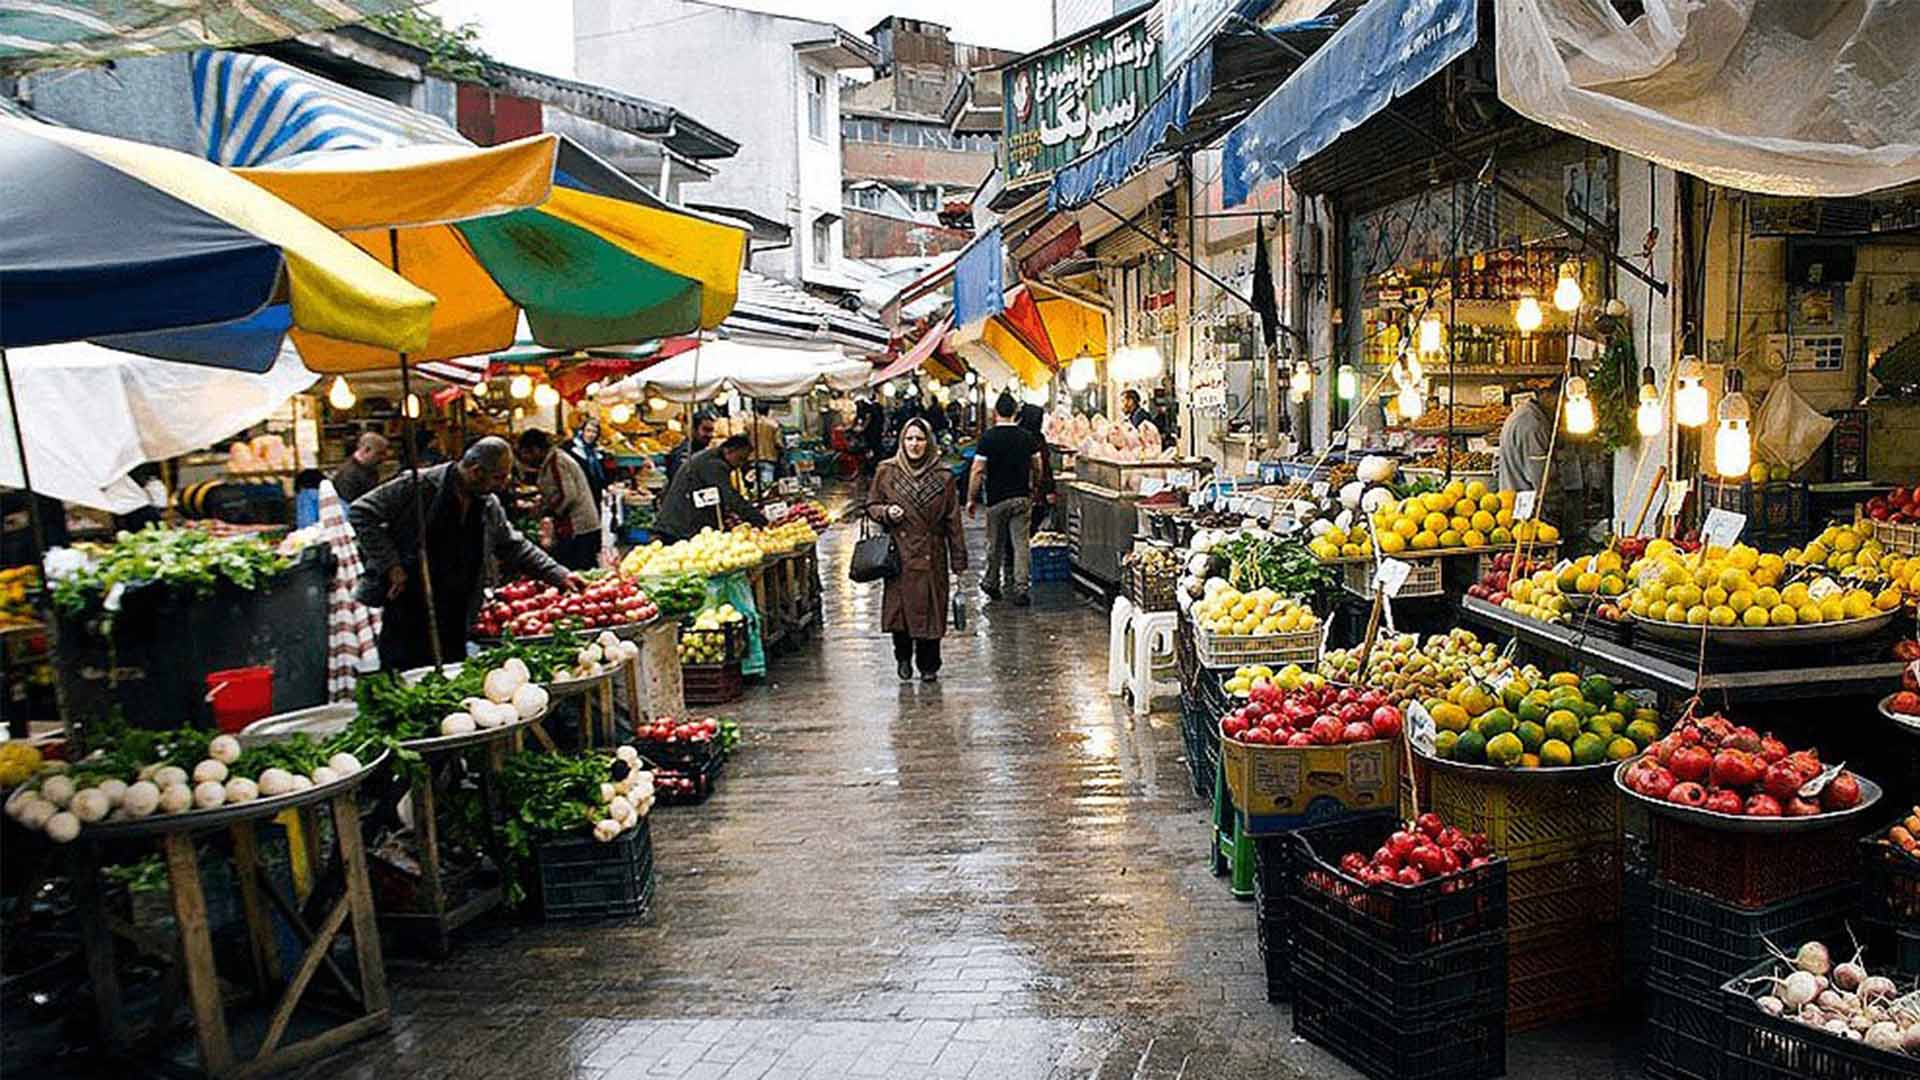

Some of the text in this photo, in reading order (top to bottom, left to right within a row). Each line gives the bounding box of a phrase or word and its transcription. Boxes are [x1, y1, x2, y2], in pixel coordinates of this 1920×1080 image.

[1083, 44, 1105, 87] مرغ
[1106, 31, 1155, 69] فروشگاه
[1034, 62, 1056, 103] مرغ
